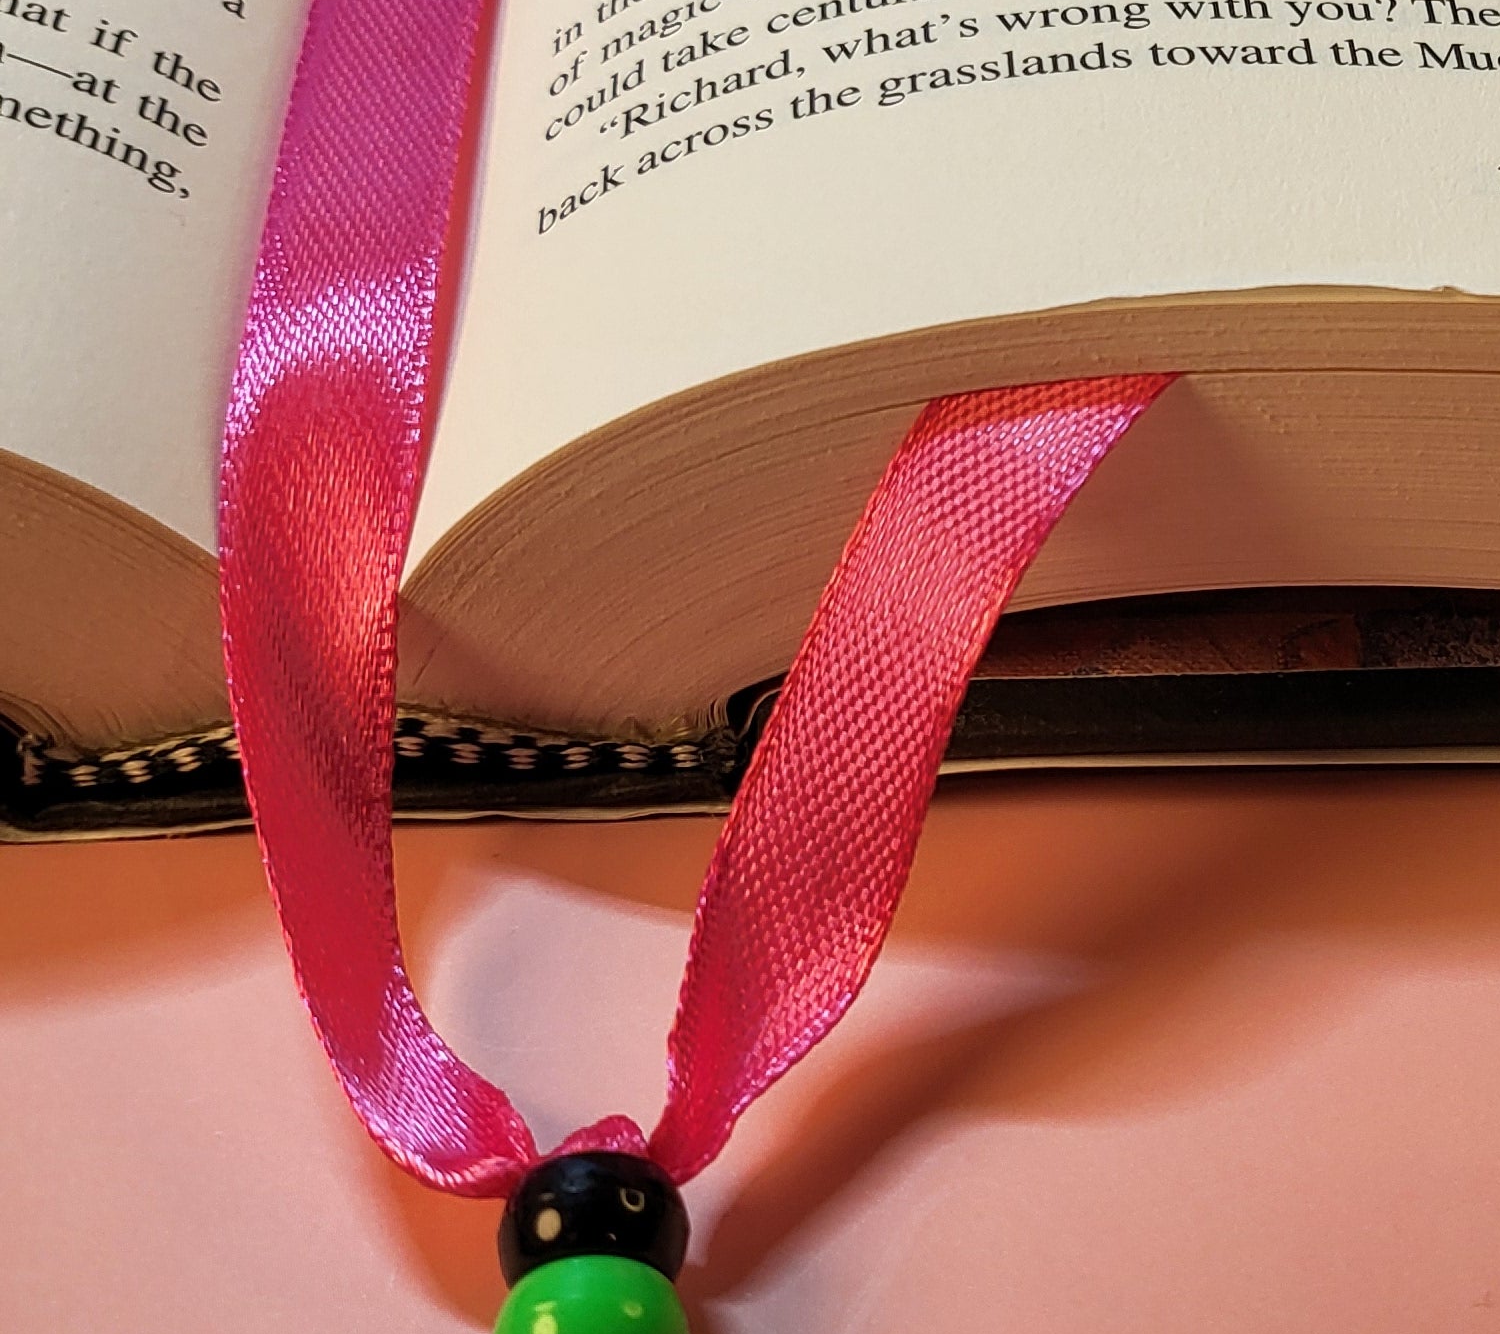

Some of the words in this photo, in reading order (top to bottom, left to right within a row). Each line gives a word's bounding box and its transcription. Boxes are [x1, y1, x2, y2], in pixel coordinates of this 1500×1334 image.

[88, 19, 140, 58] if
[150, 50, 223, 103] the
[548, 50, 589, 97] of
[552, 21, 584, 56] in
[598, 48, 807, 140] “Richard,
[820, 13, 981, 64] what’s
[994, 2, 1152, 33] wrong
[136, 94, 209, 147] the
[544, 58, 647, 142] could
[660, 26, 751, 73] take
[537, 164, 626, 235] back
[635, 108, 775, 176] across
[788, 86, 863, 120] the
[876, 41, 1134, 107] grasslands
[1146, 37, 1320, 67] toward
[1327, 38, 1405, 68] the
